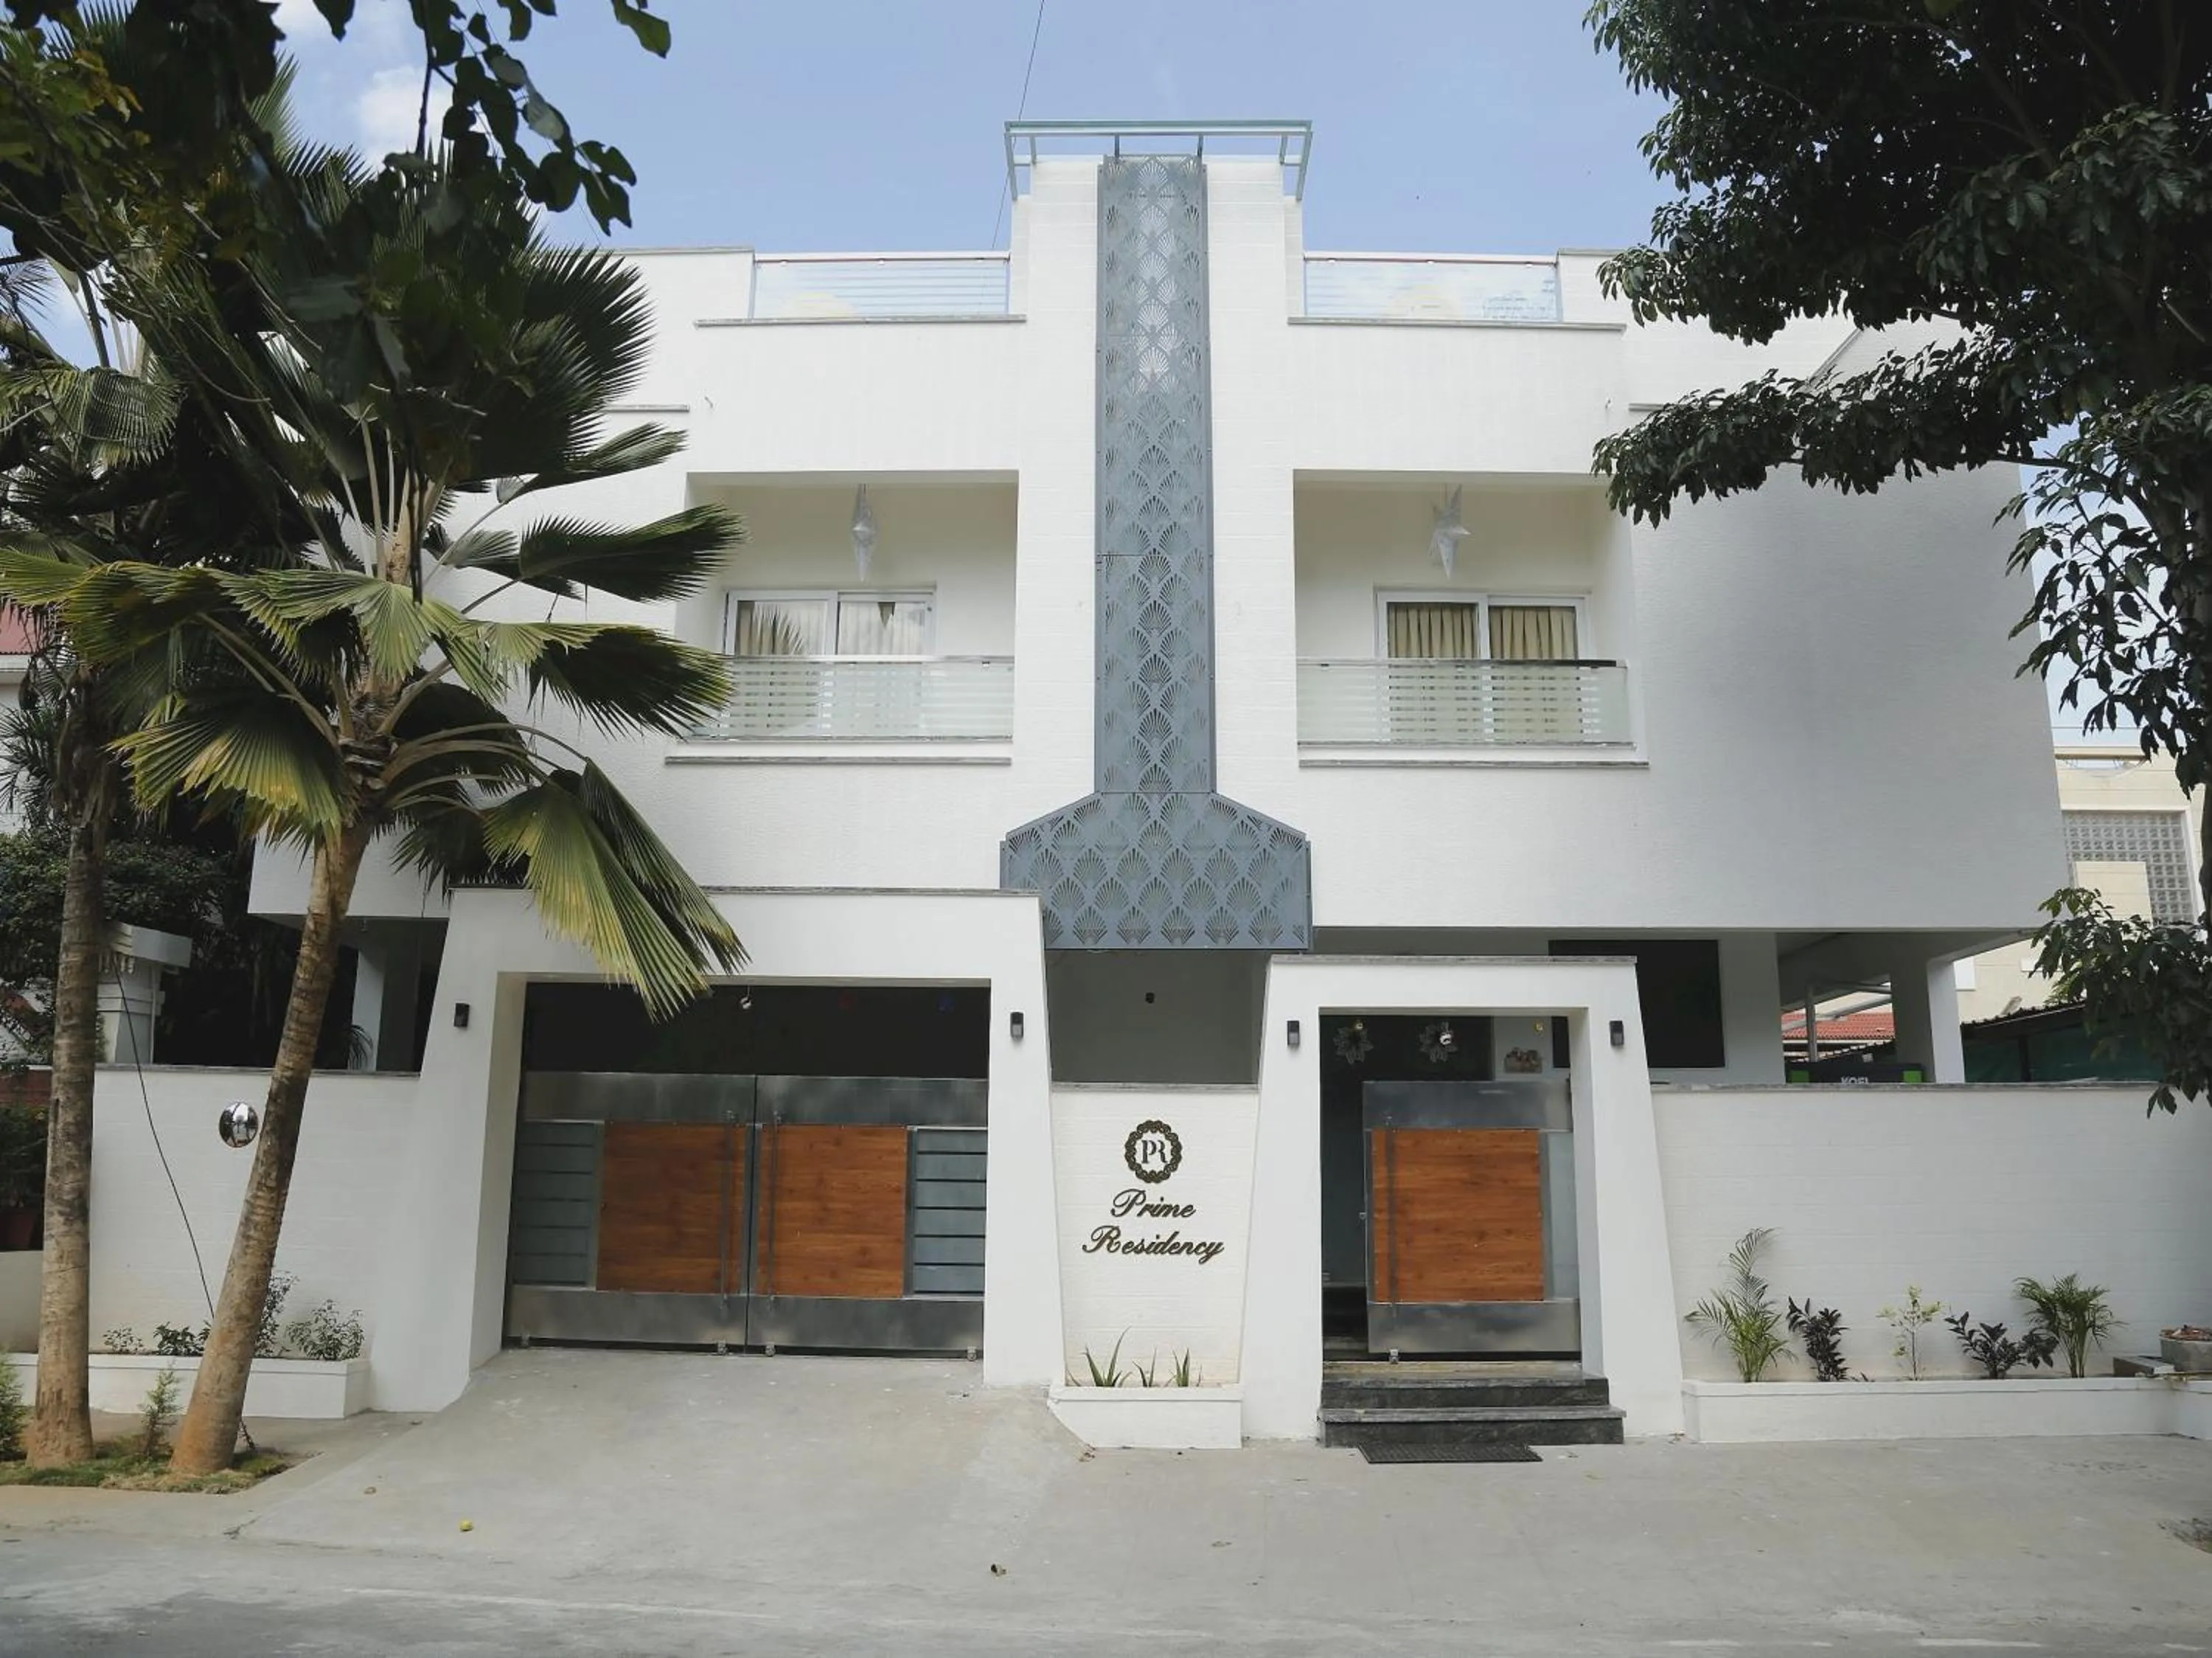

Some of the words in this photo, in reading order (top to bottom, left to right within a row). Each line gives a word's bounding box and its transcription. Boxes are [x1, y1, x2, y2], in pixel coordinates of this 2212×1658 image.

[1141, 1140, 1167, 1164] PR
[1110, 1188, 1196, 1218] Prime
[1082, 1225, 1225, 1264] Residency
